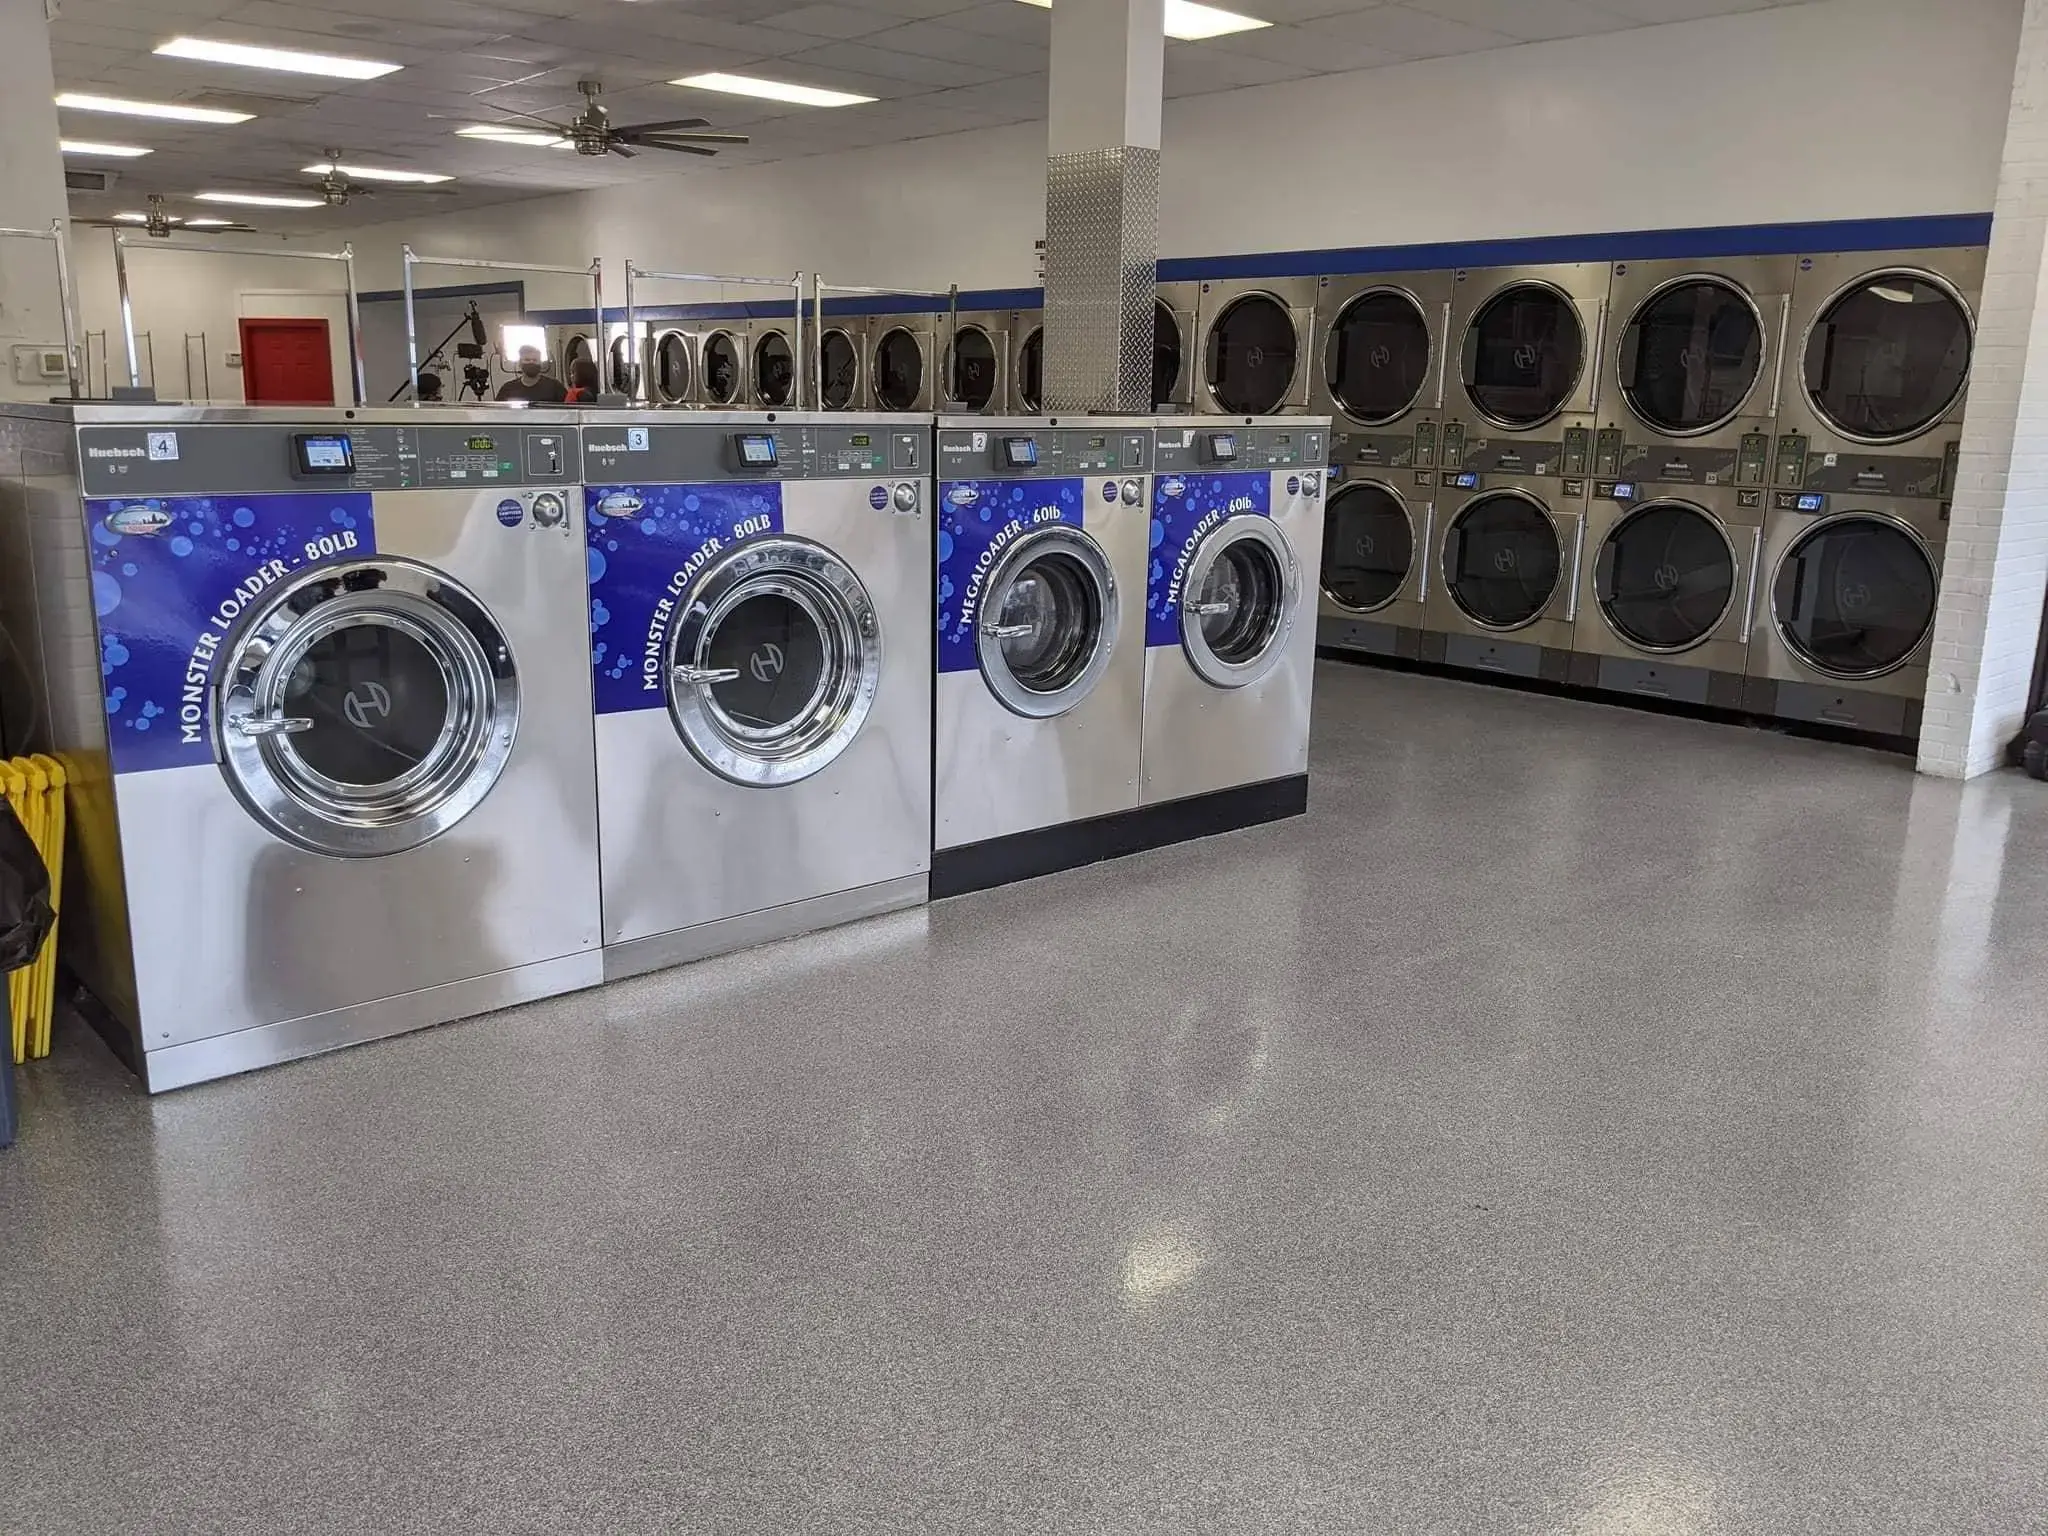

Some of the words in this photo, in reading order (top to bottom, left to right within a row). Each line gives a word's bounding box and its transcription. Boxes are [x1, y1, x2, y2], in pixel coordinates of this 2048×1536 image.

[88, 446, 146, 458] Huebsch
[158, 439, 169, 453] 4
[635, 434, 643, 446] 3
[976, 437, 984, 448] 2
[960, 519, 1022, 624] MEGALOADER
[1033, 505, 1061, 523] 60lb
[1167, 509, 1220, 603] MEGALOADER
[1229, 496, 1252, 513] 60lb
[643, 598, 674, 690] MONSTER
[667, 537, 724, 596] LOADER
[733, 514, 771, 539] 80LB
[181, 632, 222, 744] MONSTER
[210, 559, 290, 630] LOADER
[304, 530, 358, 561] 80LB
